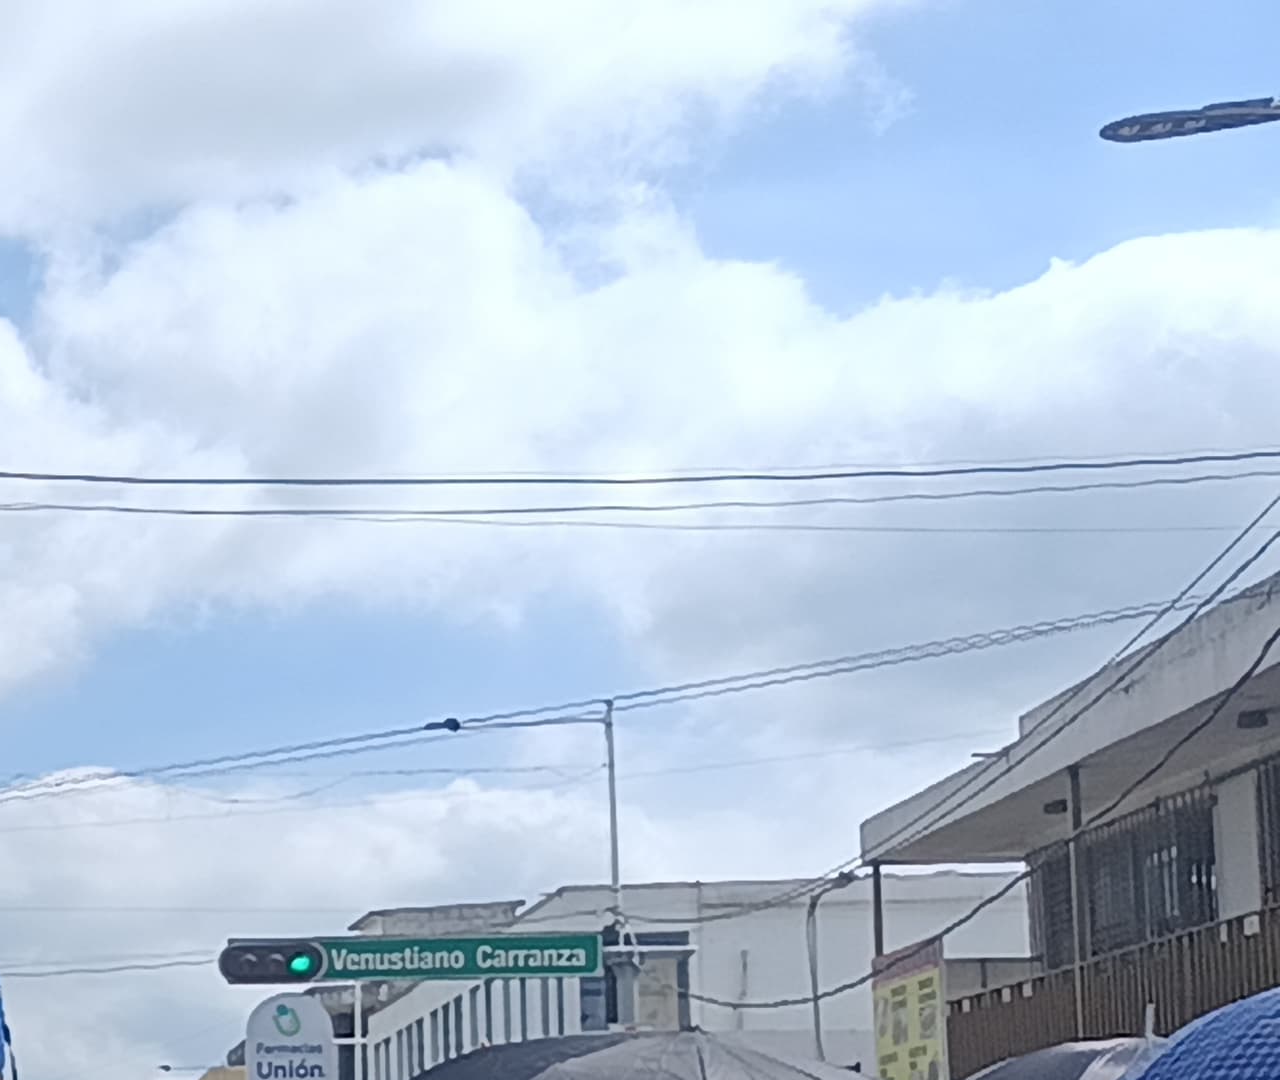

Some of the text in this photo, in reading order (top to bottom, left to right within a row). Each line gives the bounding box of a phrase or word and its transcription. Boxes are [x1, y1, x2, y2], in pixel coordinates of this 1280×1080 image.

[331, 944, 586, 971] Venustiano Carranza
[256, 1042, 323, 1054] Farmacias
[256, 1057, 324, 1080] Unión
